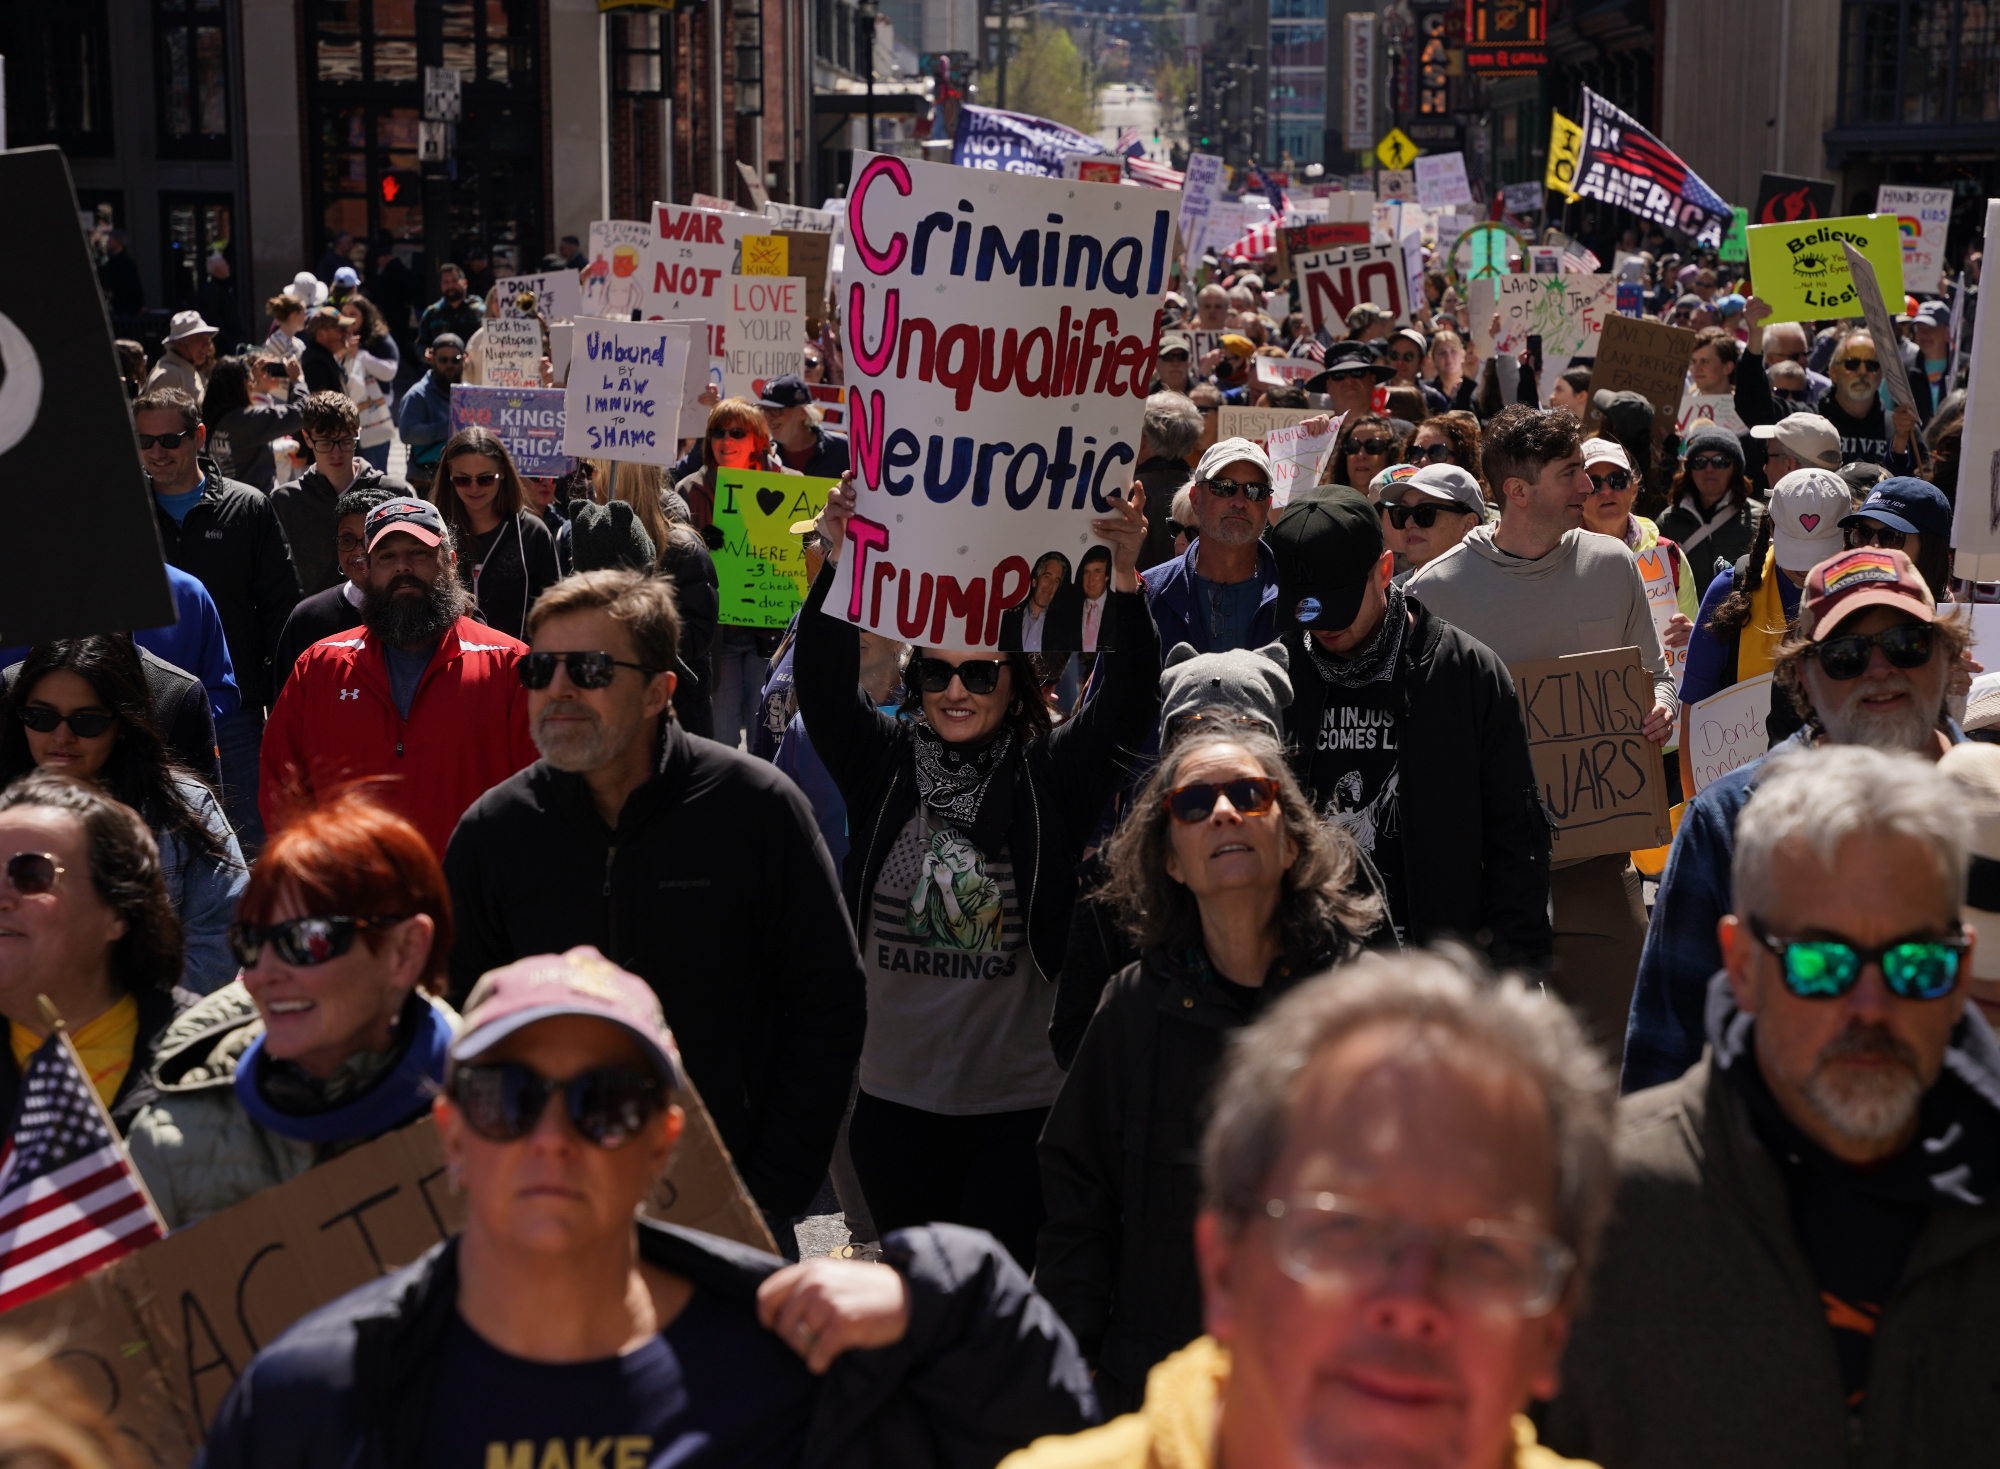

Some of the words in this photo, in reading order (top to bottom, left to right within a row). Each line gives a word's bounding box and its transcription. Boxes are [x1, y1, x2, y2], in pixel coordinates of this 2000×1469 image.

[1420, 12, 1447, 114] CASH
[963, 135, 1015, 158] NOT
[1578, 162, 1722, 249] AMERICA
[1922, 191, 1949, 206] OFF
[658, 208, 725, 245] WAR
[756, 237, 772, 247] NO
[1786, 226, 1868, 255] Believe
[679, 249, 693, 259] IS
[1304, 243, 1392, 269] JUST
[653, 261, 722, 298] NOT
[746, 265, 781, 277] KINGS
[1829, 266, 1850, 275] Eyes
[672, 300, 680, 311] A
[734, 283, 798, 313] LOVE
[1305, 261, 1402, 328] NO
[1804, 284, 1859, 308] Lies!
[1510, 299, 1536, 320] OF
[740, 319, 792, 341] YOUR
[1606, 319, 1656, 348] ONLY
[586, 331, 667, 368] Unbound
[850, 281, 1164, 412] Unqualified
[1601, 347, 1633, 367] CAN
[618, 366, 635, 378] BY
[725, 353, 806, 375] NEIGHBOR
[603, 375, 649, 395] LAW
[1612, 367, 1679, 402] FASCISM
[460, 406, 492, 425] NO
[611, 415, 626, 427] TO
[510, 428, 519, 438] IN
[851, 384, 1136, 514] Neurotic
[516, 457, 540, 468] 1776
[1276, 463, 1301, 483] NO
[722, 484, 743, 514] I
[722, 528, 789, 561] WHERE
[759, 581, 799, 591] Checks
[758, 595, 785, 609] due
[718, 612, 755, 624] C'mon
[1522, 664, 1643, 740] KINGS
[1316, 728, 1377, 751] COMES
[1699, 705, 1767, 757] Don't
[877, 943, 1018, 982] EARRINGS
[482, 1435, 655, 1469] MAKE
